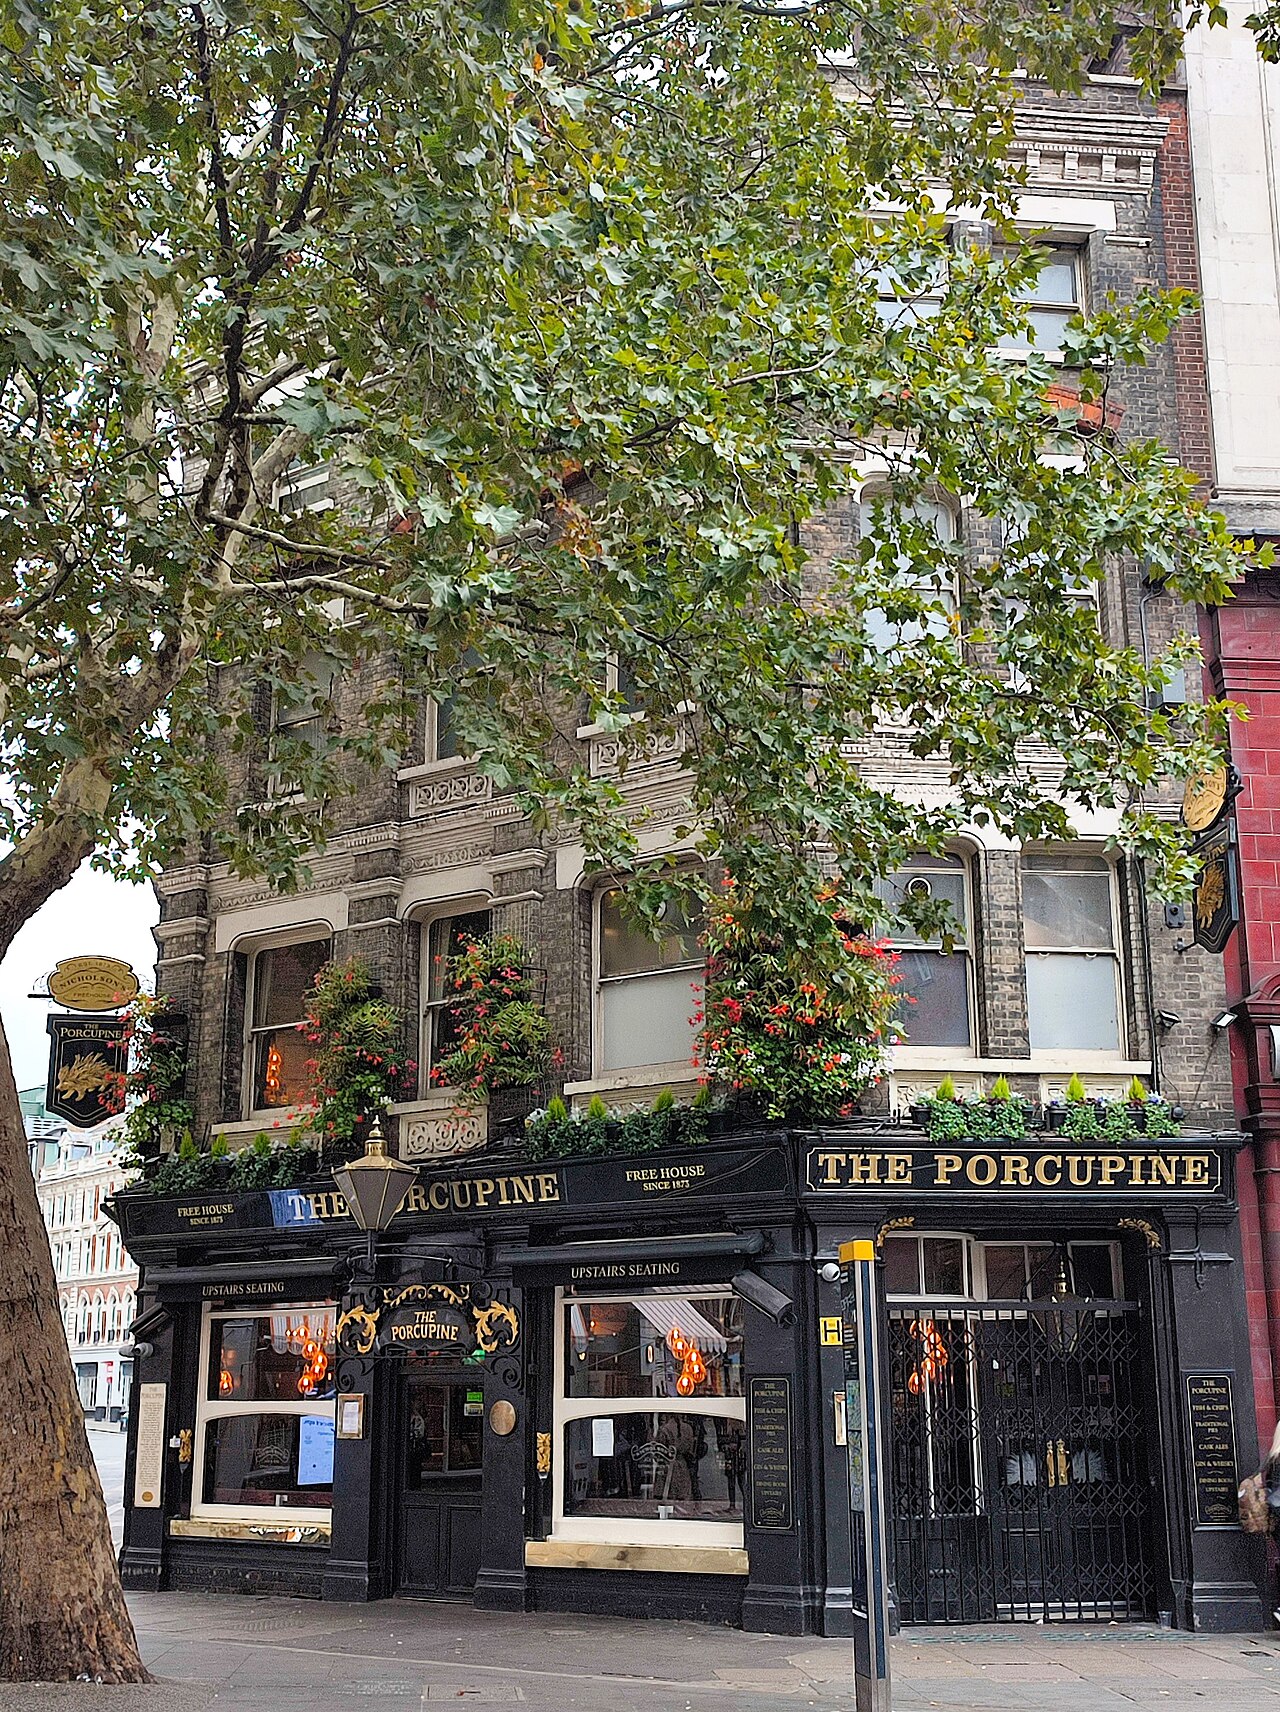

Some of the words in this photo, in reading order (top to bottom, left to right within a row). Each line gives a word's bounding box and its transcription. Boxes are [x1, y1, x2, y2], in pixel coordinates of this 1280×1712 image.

[60, 1027, 122, 1039] PORCUPINE
[625, 1169, 658, 1181] FREE
[660, 1165, 705, 1179] HOUSE
[818, 1154, 913, 1184] THE
[933, 1154, 1210, 1186] PORCUPINE
[643, 1181, 671, 1191] SINCE
[288, 1192, 350, 1220] THE
[394, 1173, 560, 1214] RCUPINE
[177, 1206, 201, 1217] FREE
[201, 1203, 234, 1215] HOUSE
[190, 1217, 210, 1226] SINCE
[571, 1264, 626, 1279] UPSTAIRS
[628, 1262, 680, 1276] SEATING
[202, 1285, 244, 1296] UPSTAIRS
[246, 1282, 285, 1294] SEATING
[414, 1310, 437, 1323] THE
[391, 1324, 459, 1341] PORCUPINE
[823, 1319, 841, 1342] H
